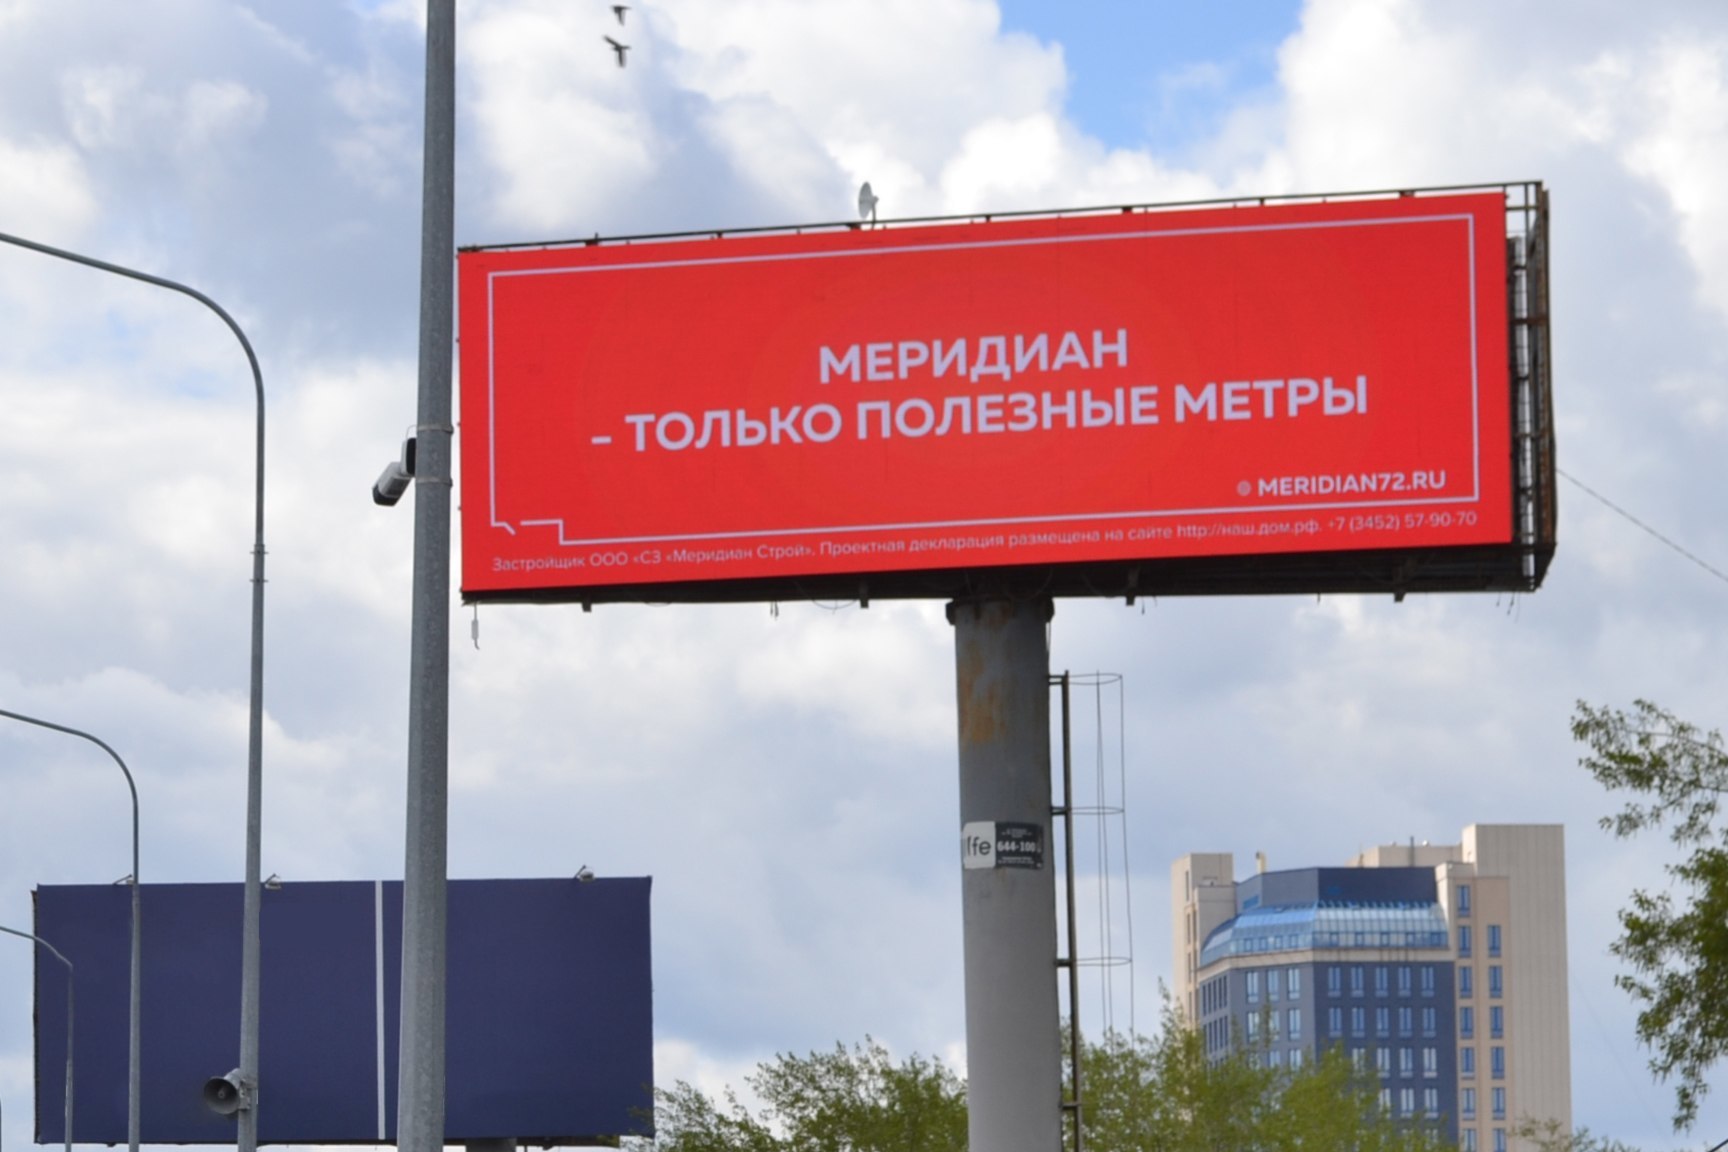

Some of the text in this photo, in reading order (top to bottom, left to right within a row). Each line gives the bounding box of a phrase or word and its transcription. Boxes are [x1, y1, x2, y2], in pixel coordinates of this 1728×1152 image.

[819, 328, 1129, 385] МЕРИДИАН
[625, 403, 842, 453] ТОЛЬКО
[856, 384, 1159, 440] ПОЛЕЗНЫЕ
[1174, 375, 1367, 423] МЕТРЫ
[1257, 470, 1446, 498] MERIDIAN72.RU
[491, 555, 586, 572] Застройщик
[589, 551, 629, 567] ООО
[819, 538, 905, 558] Проектная
[908, 534, 1006, 553] декларация
[1008, 529, 1101, 549] размещена
[1104, 528, 1124, 541] на
[1127, 524, 1173, 541] сайте
[1349, 513, 1402, 533] (3452)
[1403, 510, 1478, 530] 57-90-70
